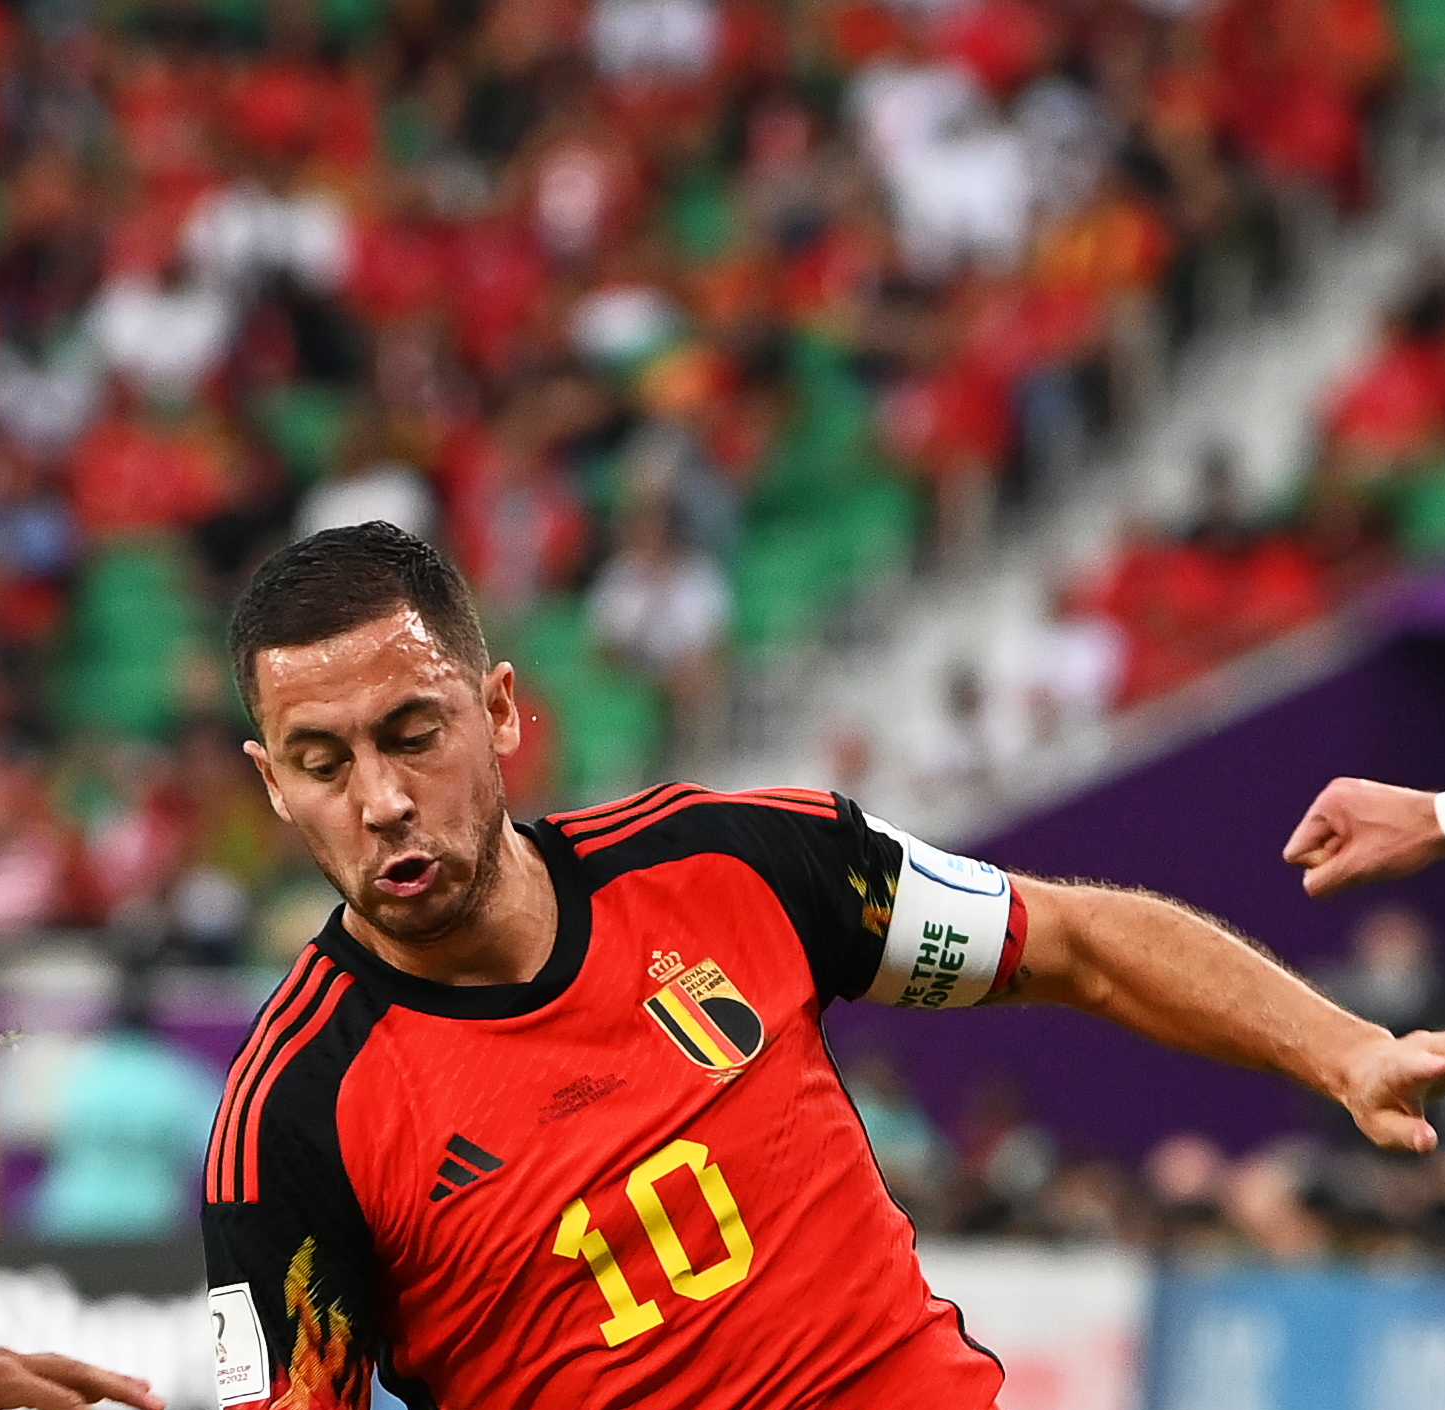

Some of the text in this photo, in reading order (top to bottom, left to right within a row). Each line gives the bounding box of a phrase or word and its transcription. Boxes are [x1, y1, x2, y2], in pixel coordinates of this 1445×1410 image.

[911, 920, 943, 981] THE
[680, 966, 708, 986] ROYAL
[685, 968, 720, 993] BELGIAN
[552, 1138, 754, 1347] 10
